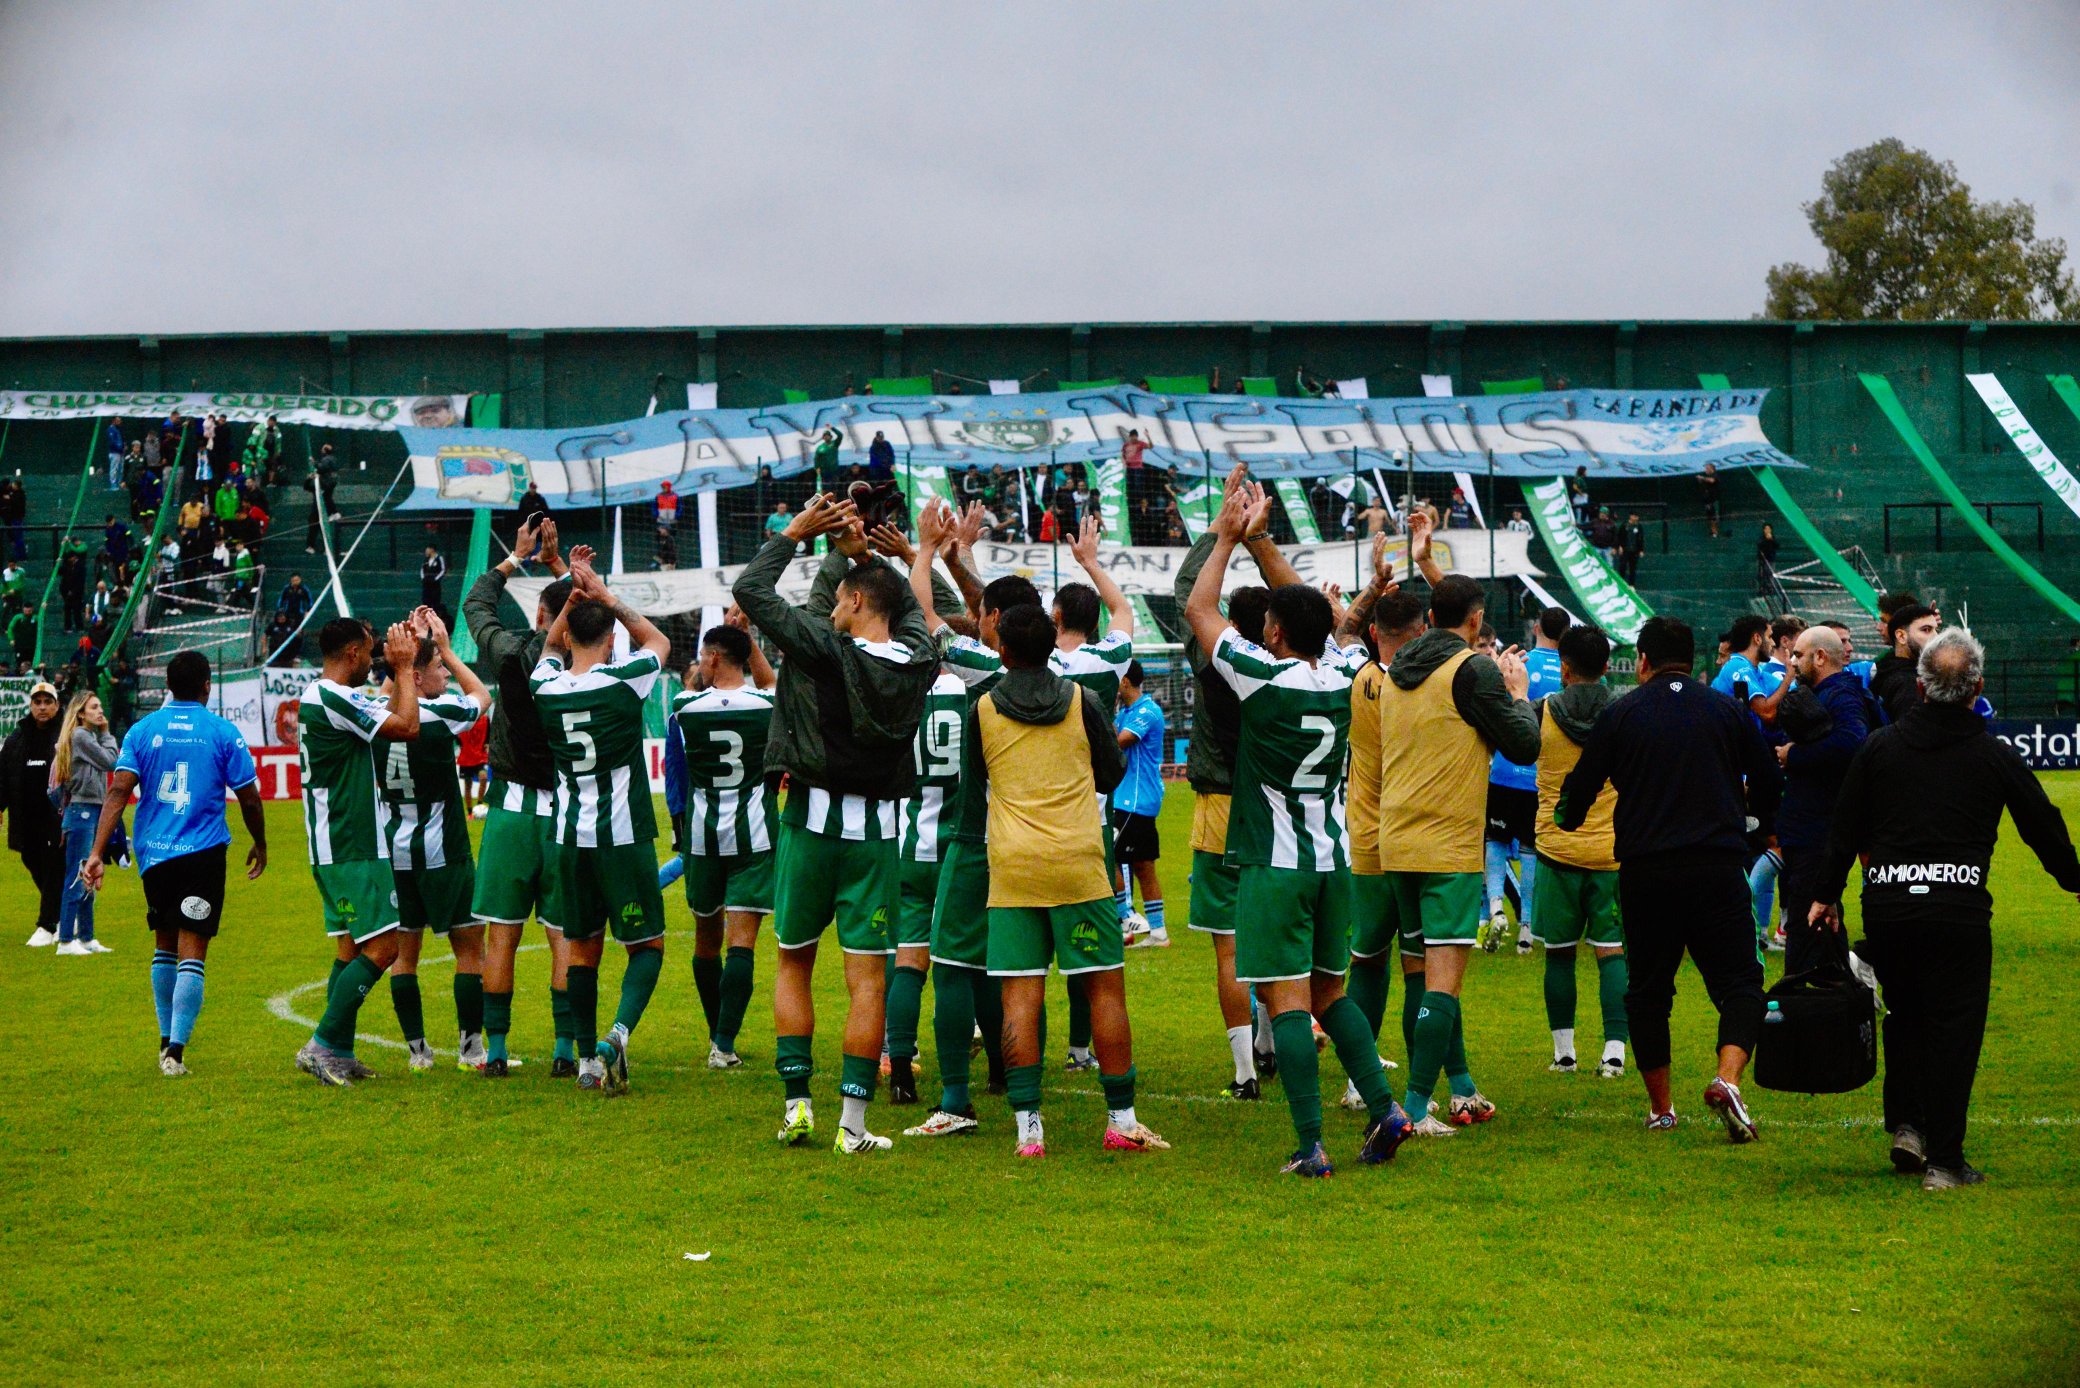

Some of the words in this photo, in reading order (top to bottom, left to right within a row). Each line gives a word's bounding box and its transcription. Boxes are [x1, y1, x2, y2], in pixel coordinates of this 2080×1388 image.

[24, 394, 184, 409] CHUECO
[210, 393, 399, 421] QUERIDO
[986, 545, 1050, 567] DE
[385, 741, 415, 799] 4
[562, 711, 596, 773] 5
[709, 730, 744, 788] 3
[1291, 715, 1336, 788] 2
[157, 761, 191, 815] 4
[1868, 863, 1981, 885] CAMIONEROS
